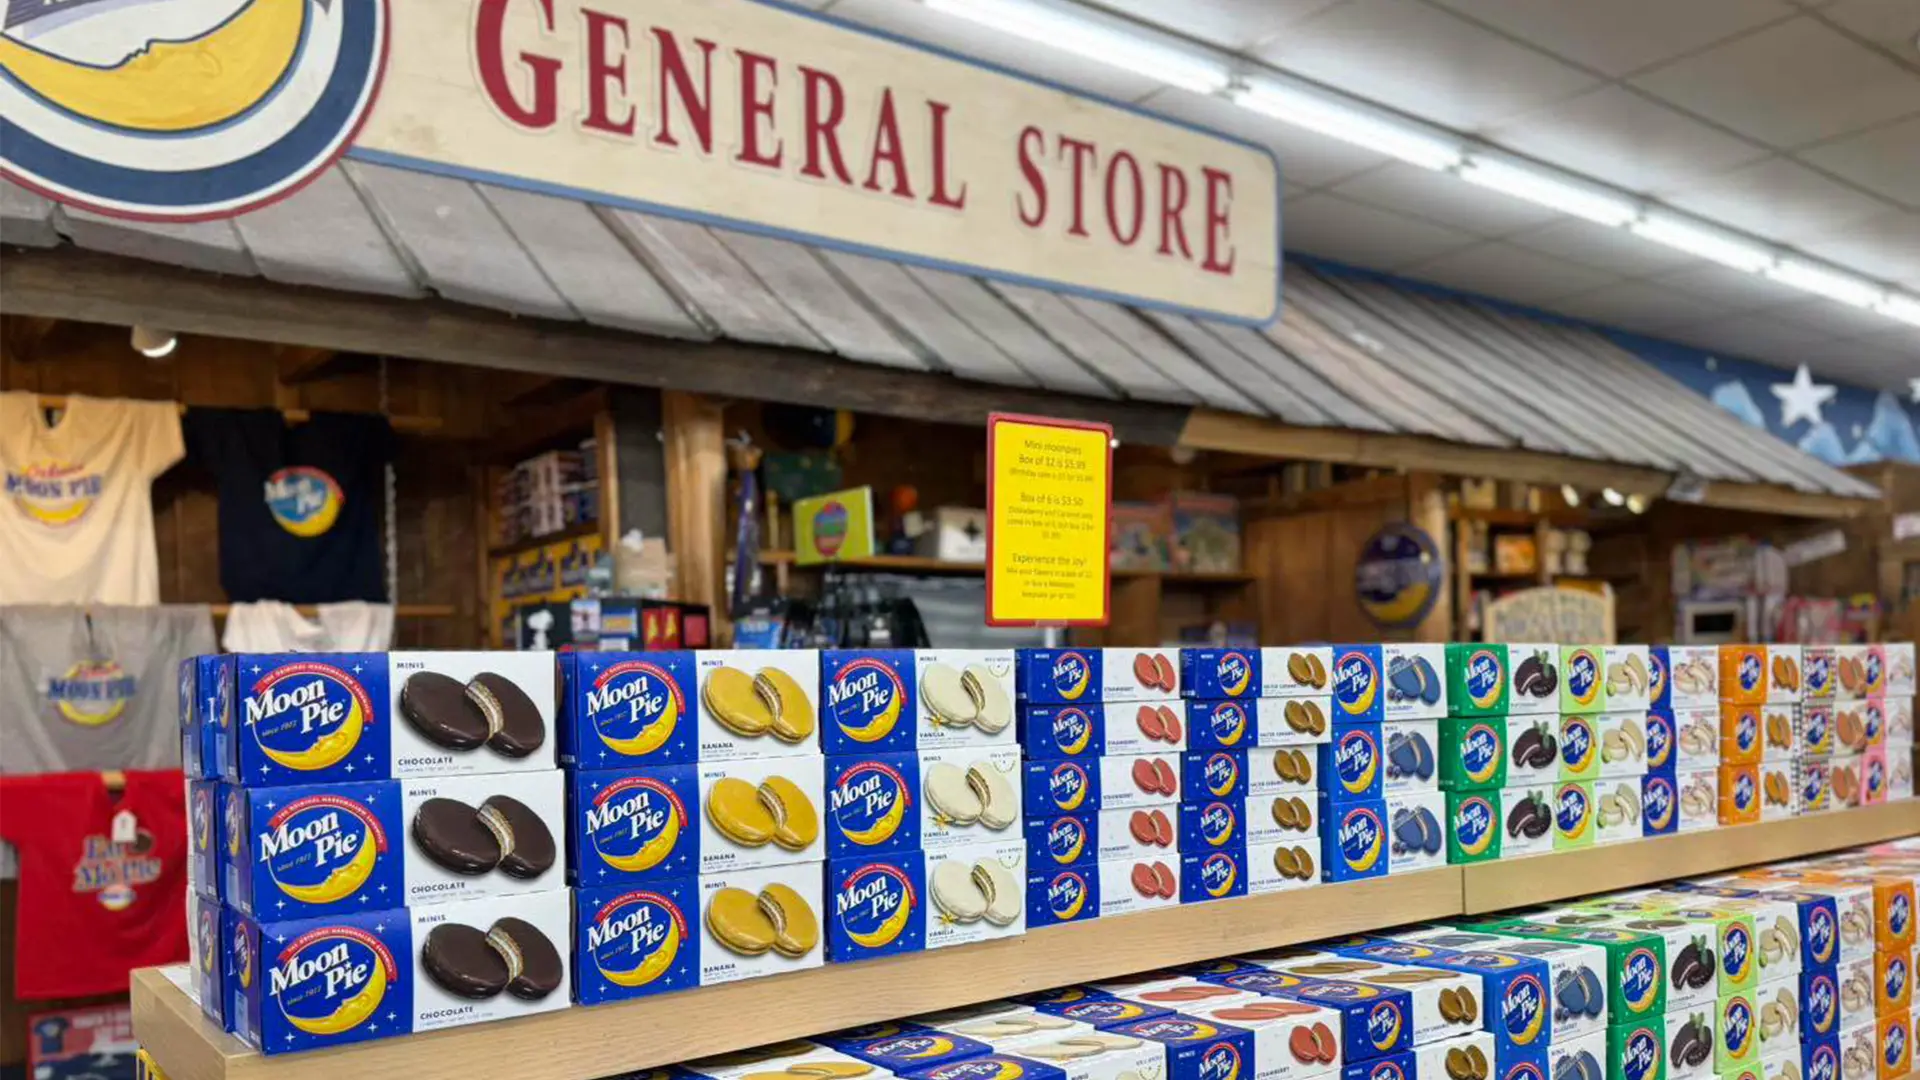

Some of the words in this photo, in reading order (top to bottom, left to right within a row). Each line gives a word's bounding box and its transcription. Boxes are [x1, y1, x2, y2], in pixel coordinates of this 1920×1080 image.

[475, 0, 968, 211] GENERAL
[1016, 125, 1237, 278] STORE
[1024, 440, 1041, 449] Mini
[1018, 454, 1033, 464] Box
[1035, 456, 1044, 465] of
[1020, 492, 1034, 503] Box
[1036, 494, 1045, 503] of
[1012, 552, 1055, 564] Experience
[1058, 556, 1070, 565] the
[1052, 659, 1077, 680] Moon
[1068, 667, 1082, 684] Pie
[1333, 661, 1362, 691] Moon
[1352, 672, 1369, 693] Pie
[586, 676, 648, 718] Moon
[629, 693, 664, 725] Pie
[828, 671, 877, 708] Moon
[861, 686, 889, 713] Pie
[244, 679, 326, 727] Moon
[301, 700, 345, 734] Pie
[1052, 715, 1078, 735] Moon
[1068, 723, 1083, 739] Pie
[702, 742, 733, 750] BANANA
[1335, 739, 1363, 767] Moon
[1353, 752, 1369, 772] Pie
[398, 756, 453, 766] CHOCOLATE
[409, 789, 437, 797] MINIS
[830, 774, 881, 812] Moon
[865, 789, 893, 817] Pie
[1050, 769, 1075, 790] Moon
[1065, 778, 1080, 795] Pie
[585, 791, 650, 835] Moon
[629, 808, 664, 840] Pie
[258, 812, 340, 862] Moon
[314, 831, 358, 867] Pie
[1048, 823, 1073, 846] Moon
[1064, 831, 1078, 848] Pie
[1338, 818, 1367, 847] Moon
[1358, 828, 1374, 850] Pie
[703, 852, 736, 863] BANANA
[411, 881, 466, 894] CHOCOLATE
[836, 876, 887, 915] Moon
[871, 890, 898, 919] Pie
[1048, 878, 1073, 901] Moon
[1064, 887, 1078, 903] Pie
[418, 914, 446, 923] MINIS
[586, 905, 651, 953] Moon
[630, 922, 665, 954] Pie
[268, 942, 350, 996] Moon
[324, 961, 368, 999] Pie
[703, 963, 736, 973] BANANA
[1620, 956, 1647, 986] Moon
[1637, 968, 1653, 990] Pie
[420, 1006, 474, 1020] CHOCOLATE
[1501, 983, 1531, 1020] Moon
[1520, 997, 1537, 1021] Pie
[1367, 1007, 1390, 1032] Moon
[1381, 1015, 1395, 1034] Pie
[1199, 1050, 1226, 1079] Moon
[1216, 1059, 1232, 1078] Pie
[1620, 1036, 1648, 1069] Moon
[1638, 1049, 1653, 1071] Pie
